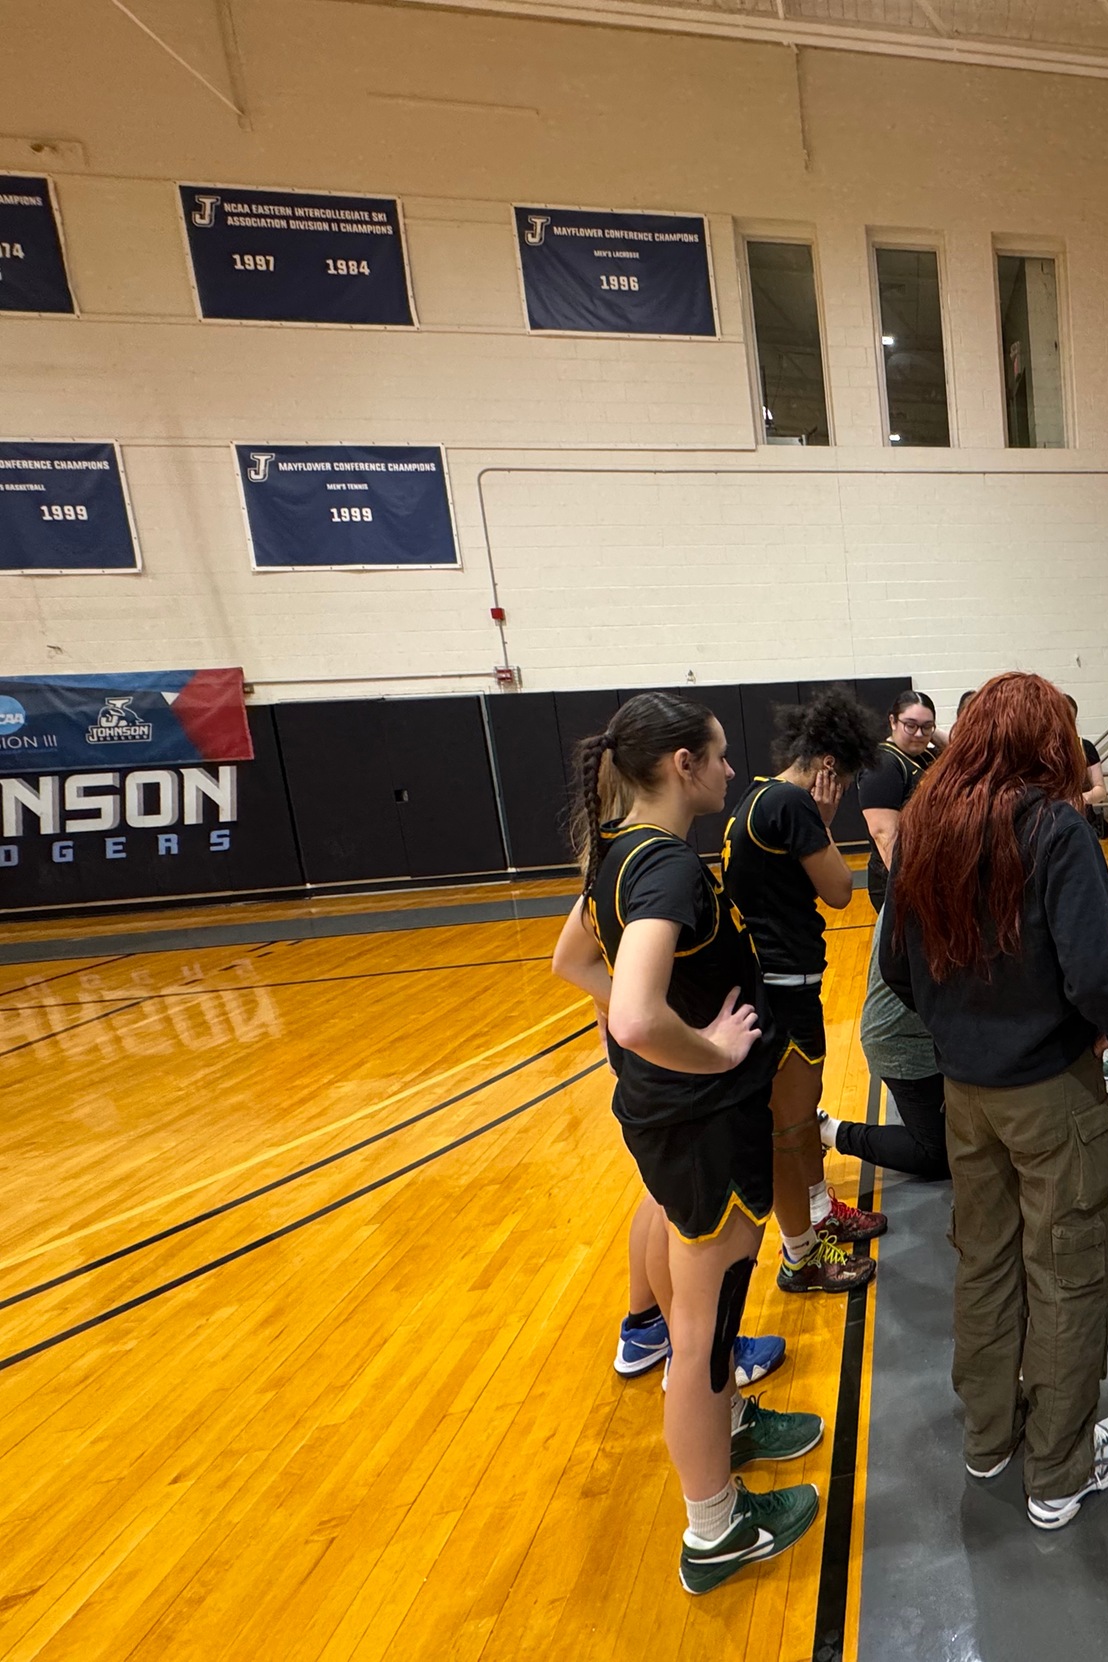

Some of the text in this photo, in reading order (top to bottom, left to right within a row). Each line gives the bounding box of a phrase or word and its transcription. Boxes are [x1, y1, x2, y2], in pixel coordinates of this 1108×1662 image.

[192, 195, 221, 227] J
[223, 203, 387, 222] NCAA EASTERN INTERCOLLEGIATE SKI
[227, 216, 393, 235] ASSOCIATION DIVISION II CHAMPIONS
[524, 215, 551, 246] J
[553, 226, 699, 243] MAYFLOWER CONFERENCE CHAMPIONS
[0, 242, 25, 259] 74
[232, 254, 370, 276] 1997 1984
[600, 275, 640, 292] 1996
[54, 460, 110, 470] CHAMPIONS
[247, 453, 275, 483] J
[278, 462, 436, 472] MAYFLOWER CONFERENCE CHAMPIONS
[5, 483, 46, 491] BASKETBALL
[40, 505, 88, 521] 1999
[330, 507, 373, 522] 1999
[0, 735, 38, 749] ION
[89, 726, 148, 741] JOHNSON
